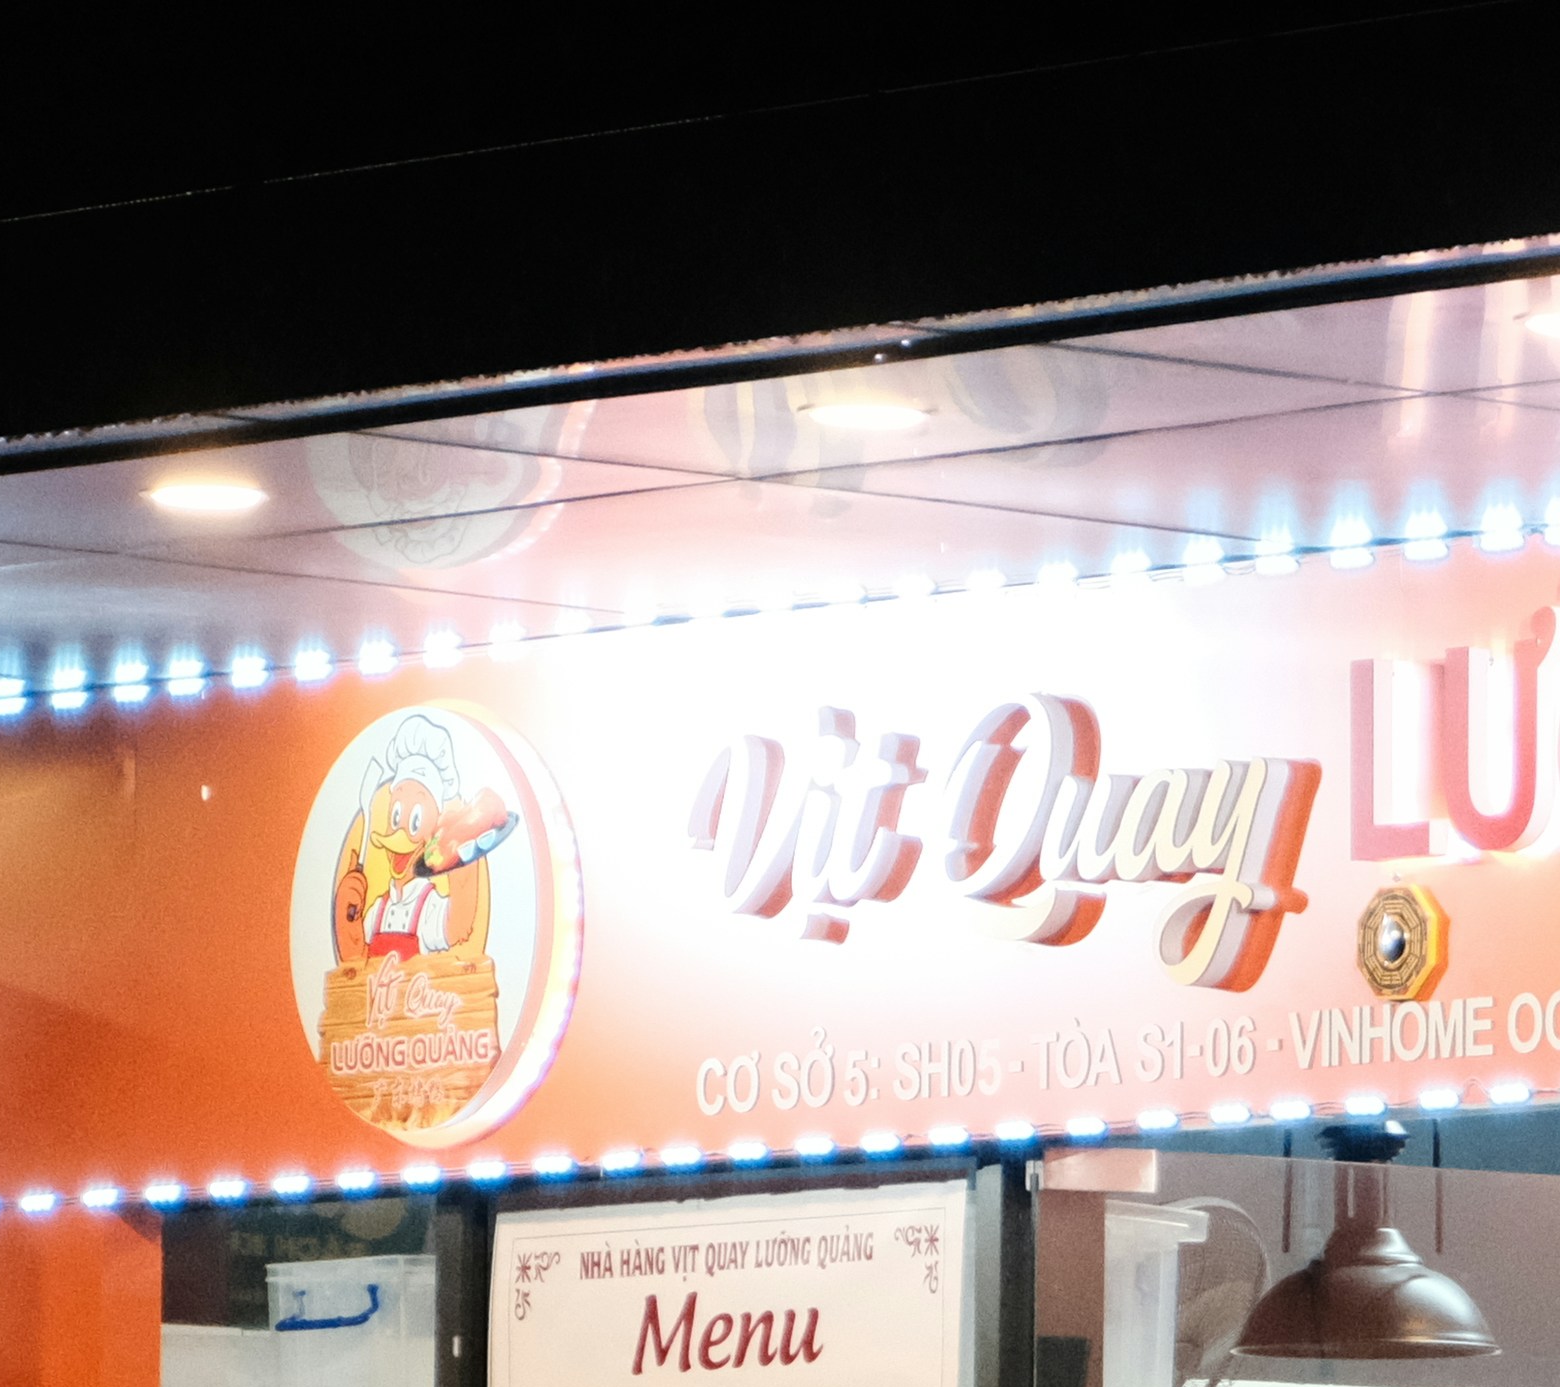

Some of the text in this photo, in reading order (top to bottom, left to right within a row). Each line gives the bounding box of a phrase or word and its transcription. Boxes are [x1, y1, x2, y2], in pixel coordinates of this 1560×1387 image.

[687, 705, 930, 944] Vịt
[945, 692, 1323, 993] Quay
[331, 1033, 406, 1072] LƯỠNG
[695, 1050, 761, 1116] CƠ
[771, 1025, 836, 1108] SỞ
[843, 1053, 881, 1105] 5:
[893, 1036, 1002, 1101] SH05
[1030, 1017, 1124, 1091] TÒA
[1135, 1016, 1257, 1083] S1-06
[1288, 996, 1494, 1069] VINHOME
[580, 1225, 874, 1282] NHÀ HÀNG VỊT QUAY LƯỠNG QUẢNG
[632, 1291, 824, 1376] Menu
